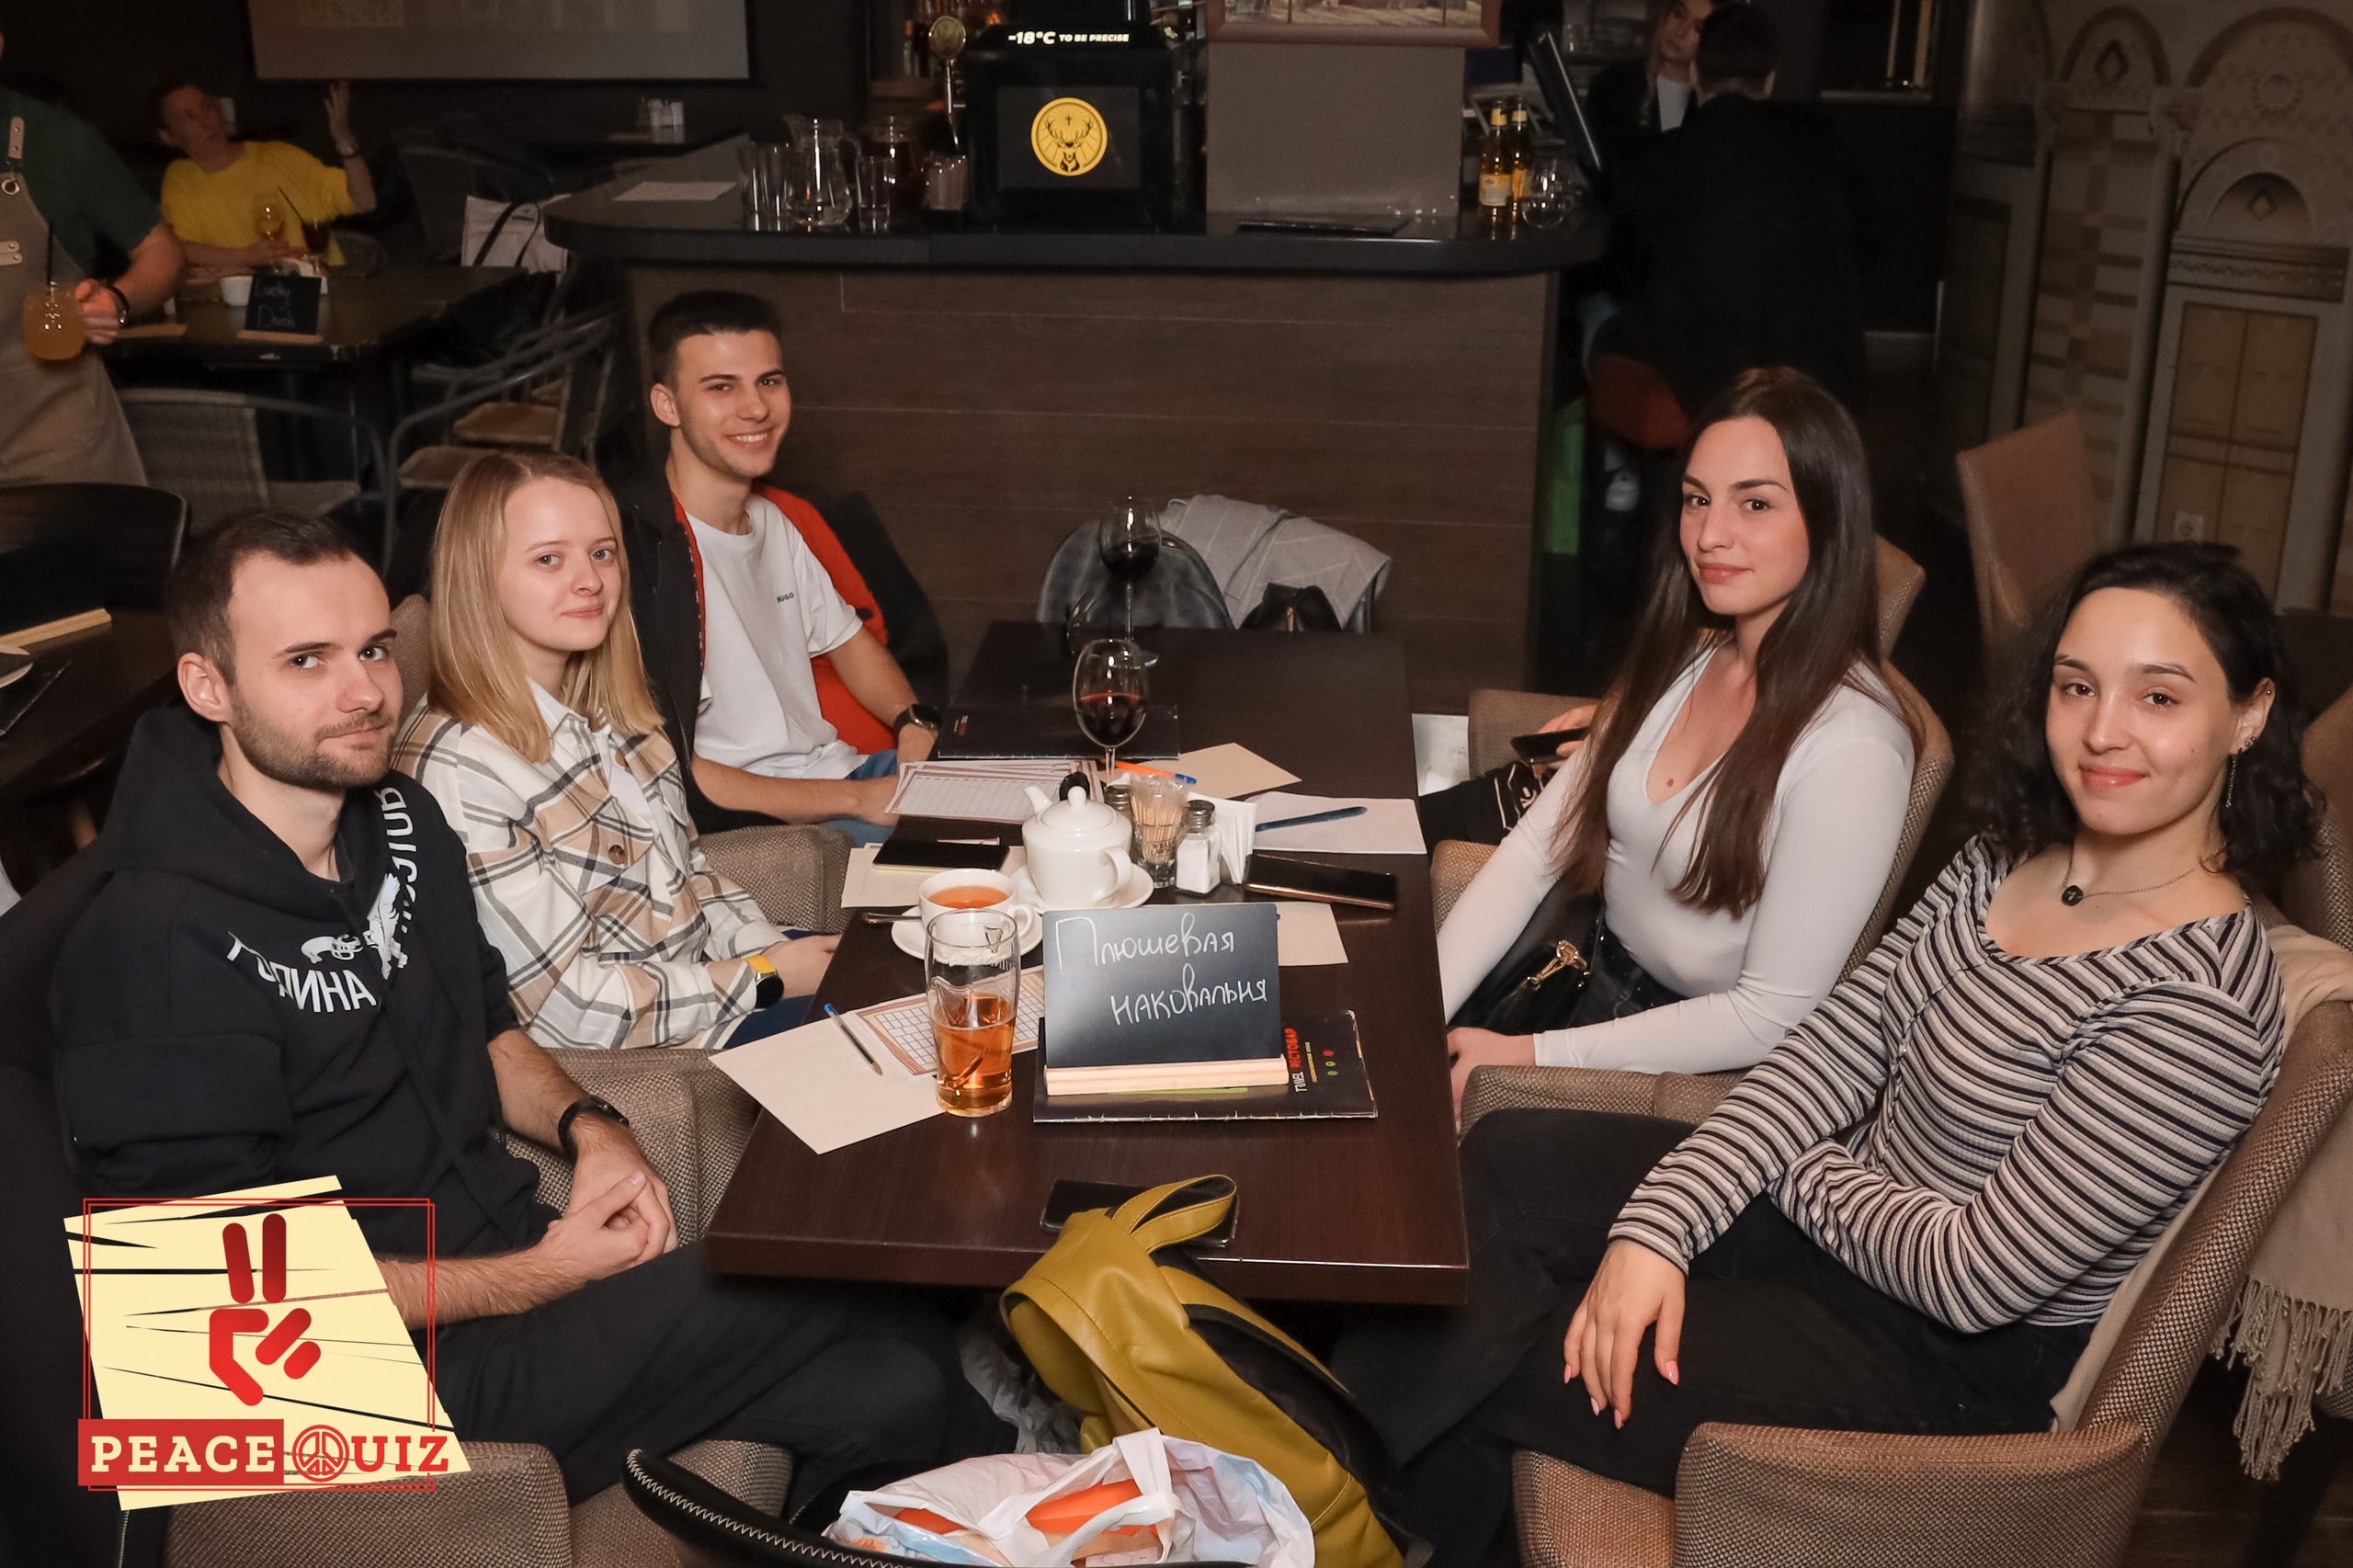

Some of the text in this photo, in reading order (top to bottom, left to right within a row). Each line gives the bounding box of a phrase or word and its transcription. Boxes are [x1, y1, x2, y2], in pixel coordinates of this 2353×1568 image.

[1059, 34, 1073, 42] TO
[1074, 34, 1087, 42] BE
[1089, 34, 1130, 42] PRECISE
[777, 592, 794, 603] HUGO
[1054, 912, 1234, 971] Плюшевая
[1284, 1027, 1302, 1068] РЕСТОБАР
